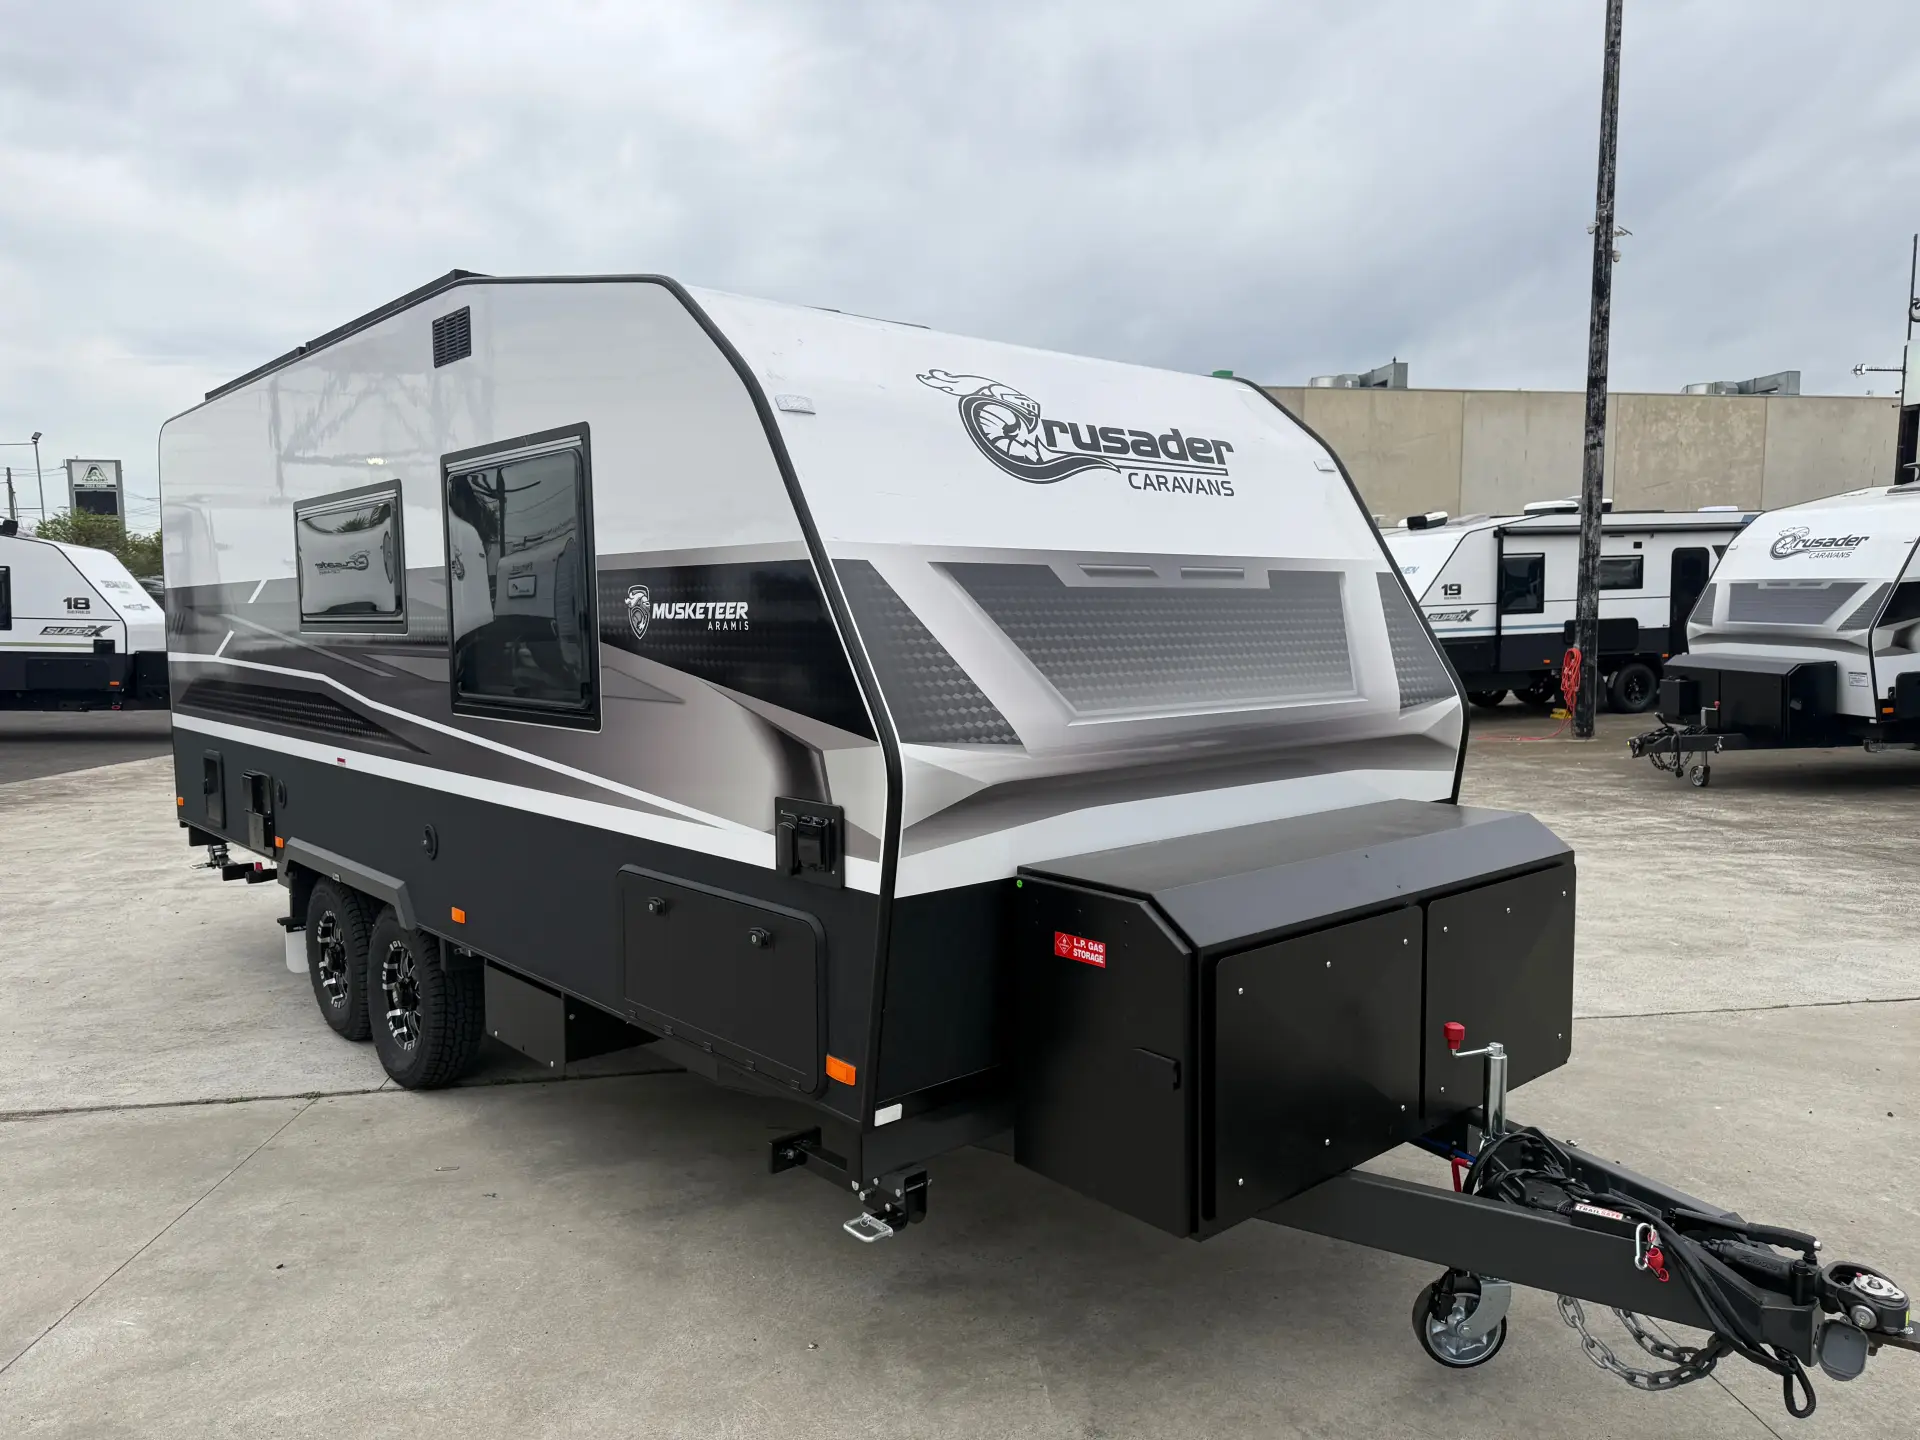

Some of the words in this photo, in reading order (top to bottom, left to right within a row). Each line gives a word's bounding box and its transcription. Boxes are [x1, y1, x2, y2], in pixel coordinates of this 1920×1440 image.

[1127, 472, 1235, 497] CARAVANS
[1808, 551, 1853, 559] CARAVANS
[1441, 584, 1462, 596] 19
[63, 597, 91, 610] 18
[652, 601, 749, 620] MUSKETEER
[707, 620, 749, 631] ARAMIS
[1088, 942, 1104, 953] GAS
[1073, 948, 1104, 963] STORAGE
